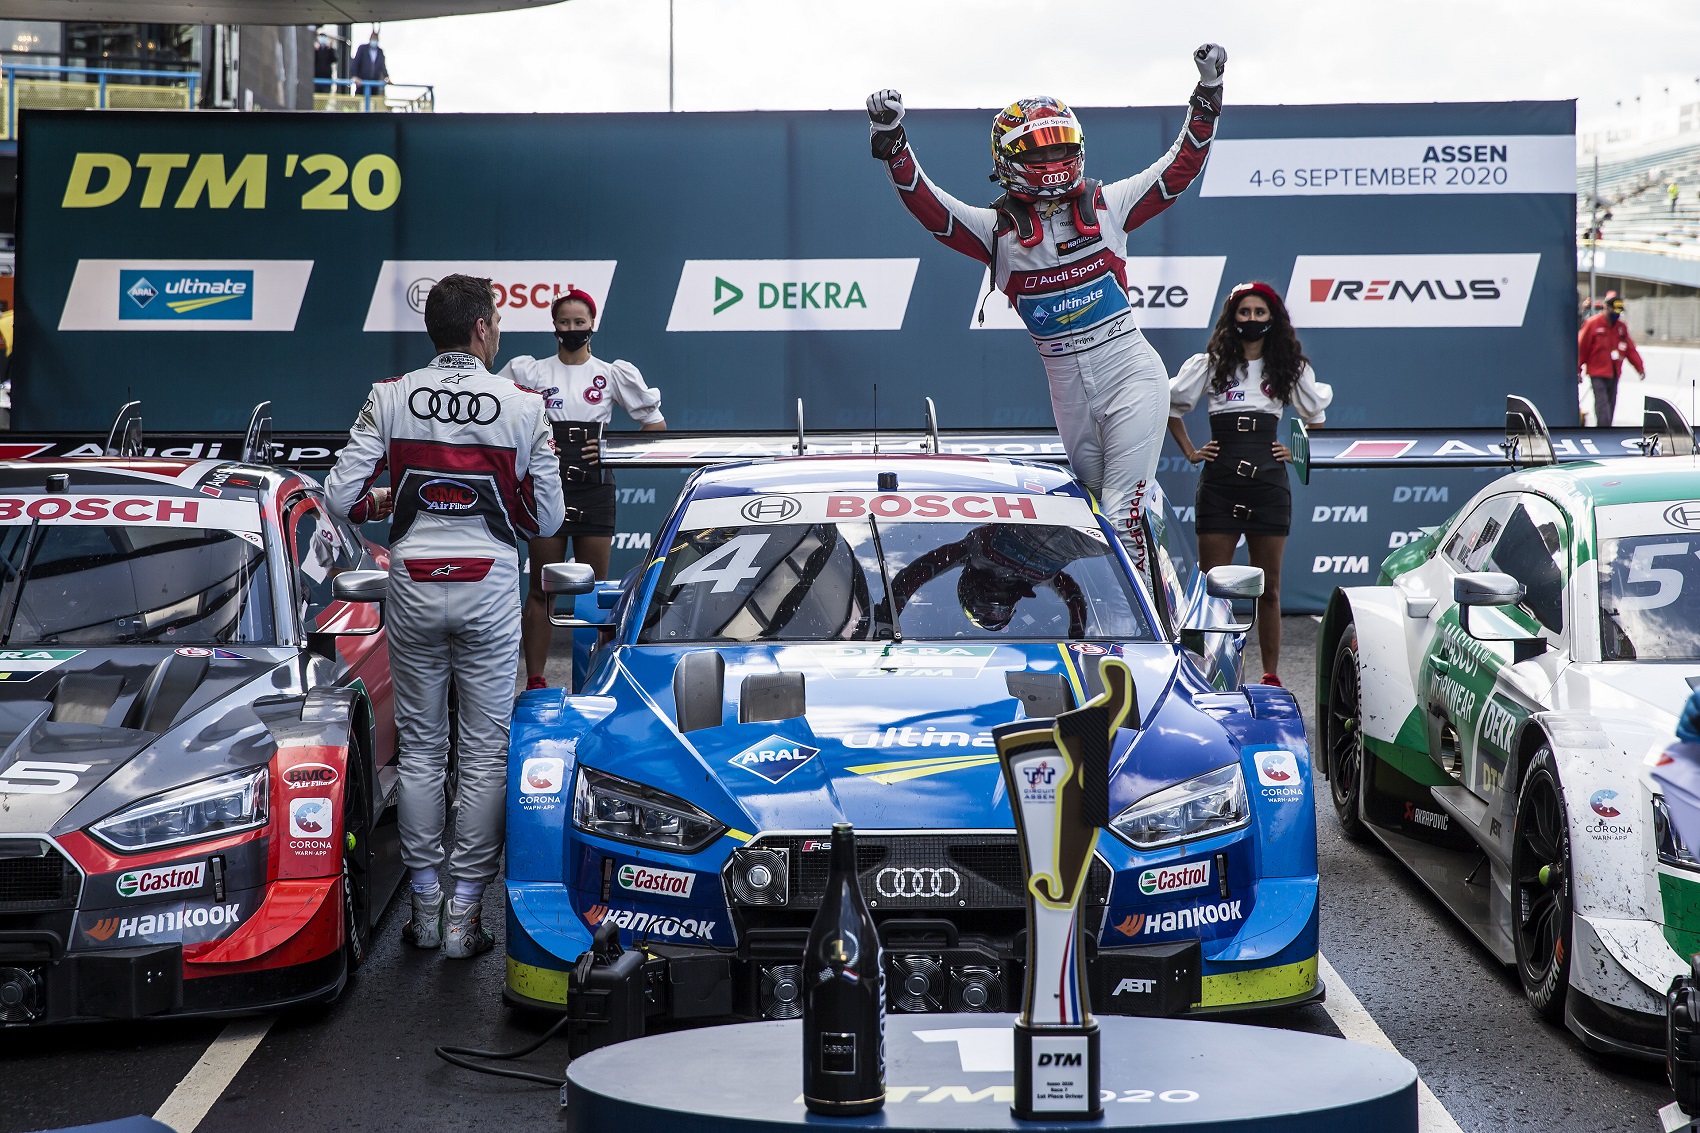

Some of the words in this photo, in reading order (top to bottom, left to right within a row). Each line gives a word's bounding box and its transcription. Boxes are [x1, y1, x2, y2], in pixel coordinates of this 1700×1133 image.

[1422, 145, 1507, 163] ASSEN
[61, 153, 268, 209] DTM
[284, 153, 401, 211] '20
[1249, 168, 1286, 187] 4-6
[1294, 167, 1437, 187] SEPTEMBER
[1446, 166, 1508, 186] 2020
[1040, 271, 1069, 285] Audi
[1070, 258, 1105, 278] Sport
[131, 288, 154, 296] ARAL
[165, 277, 247, 295] ultimate
[758, 281, 867, 309] DEKRA
[1330, 279, 1501, 303] REMUS
[1052, 288, 1104, 314] ultimate
[426, 486, 473, 504] BMC
[1392, 486, 1449, 503] DTM
[427, 501, 449, 510] Air
[449, 502, 470, 510] Filter
[825, 495, 1037, 520] BOSCH
[1311, 505, 1369, 523] DTM
[671, 533, 772, 594] 4
[1311, 556, 1370, 573] DTM
[842, 726, 997, 749] ultima
[741, 748, 808, 764] ARAL
[289, 769, 333, 782] BMC
[289, 781, 311, 790] Air
[311, 780, 330, 788] Filter
[1261, 787, 1304, 797] CORONA
[518, 795, 561, 805] CORONA
[1585, 825, 1633, 835] CORONA
[289, 840, 332, 849] CORONA
[139, 866, 200, 892] Castrol
[634, 869, 690, 895] Castrol
[1156, 865, 1207, 890] Castrol
[1112, 978, 1157, 996] ABT
[1037, 1052, 1082, 1067] DTM
